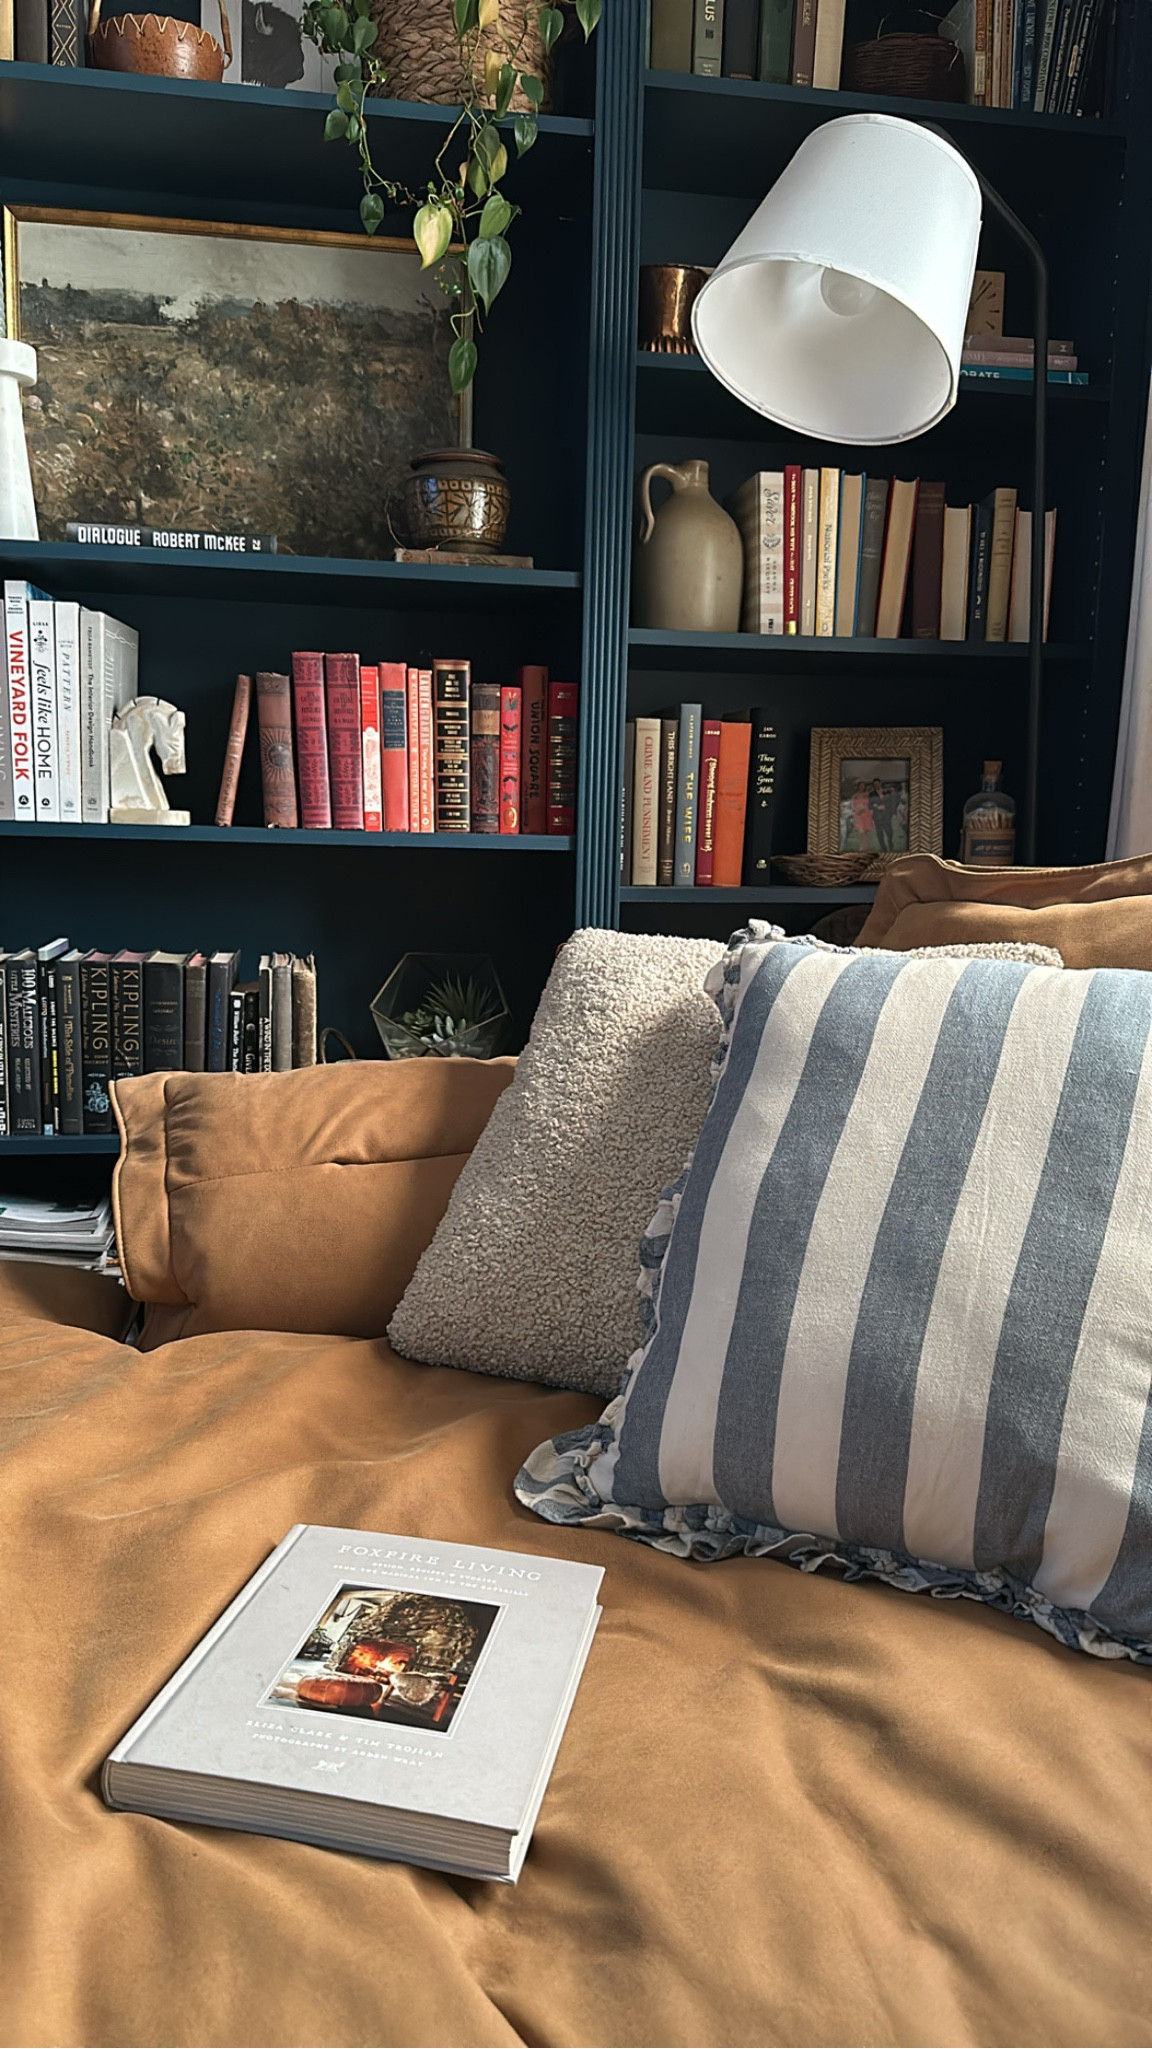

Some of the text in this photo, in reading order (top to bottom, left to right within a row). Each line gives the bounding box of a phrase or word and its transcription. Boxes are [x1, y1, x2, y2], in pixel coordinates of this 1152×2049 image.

[78, 526, 141, 546] DIALOGUE
[153, 531, 200, 549] ROBERT
[822, 524, 833, 591] National Parks
[9, 630, 27, 726] VINEYARD
[62, 652, 71, 712] PATTERN
[419, 674, 429, 708] LAUREN
[32, 660, 52, 779] feels like HOME
[13, 731, 30, 780] FOLK
[529, 701, 540, 799] UNION SQUARE
[644, 736, 653, 768] CRIME
[666, 731, 675, 804] THIS BRIGHT LAND
[757, 753, 776, 762] These
[644, 773, 653, 794] AND
[757, 765, 775, 773] High
[683, 772, 694, 844] THE WIFE
[757, 785, 773, 794] Hills
[642, 797, 653, 861] PUNISHMENT
[9, 992, 22, 1048] MYSTERIES
[22, 969, 37, 1048] 100 MALICIOUS
[91, 967, 108, 1050] KIPLING
[122, 969, 140, 1052] KIPLING
[64, 1039, 74, 1056] Side
[264, 1024, 272, 1042] WIND
[264, 1043, 272, 1051] IN
[264, 1051, 272, 1064] THE
[64, 1066, 74, 1102] Paradise
[338, 1545, 541, 1581] FOXFIRE LIVING
[246, 1720, 283, 1731] ELIZA
[290, 1726, 333, 1738] CLARK
[355, 1737, 381, 1746] TIM
[386, 1743, 443, 1758] TROJIAN
[252, 1733, 329, 1750] PHOTOGRAPHS
